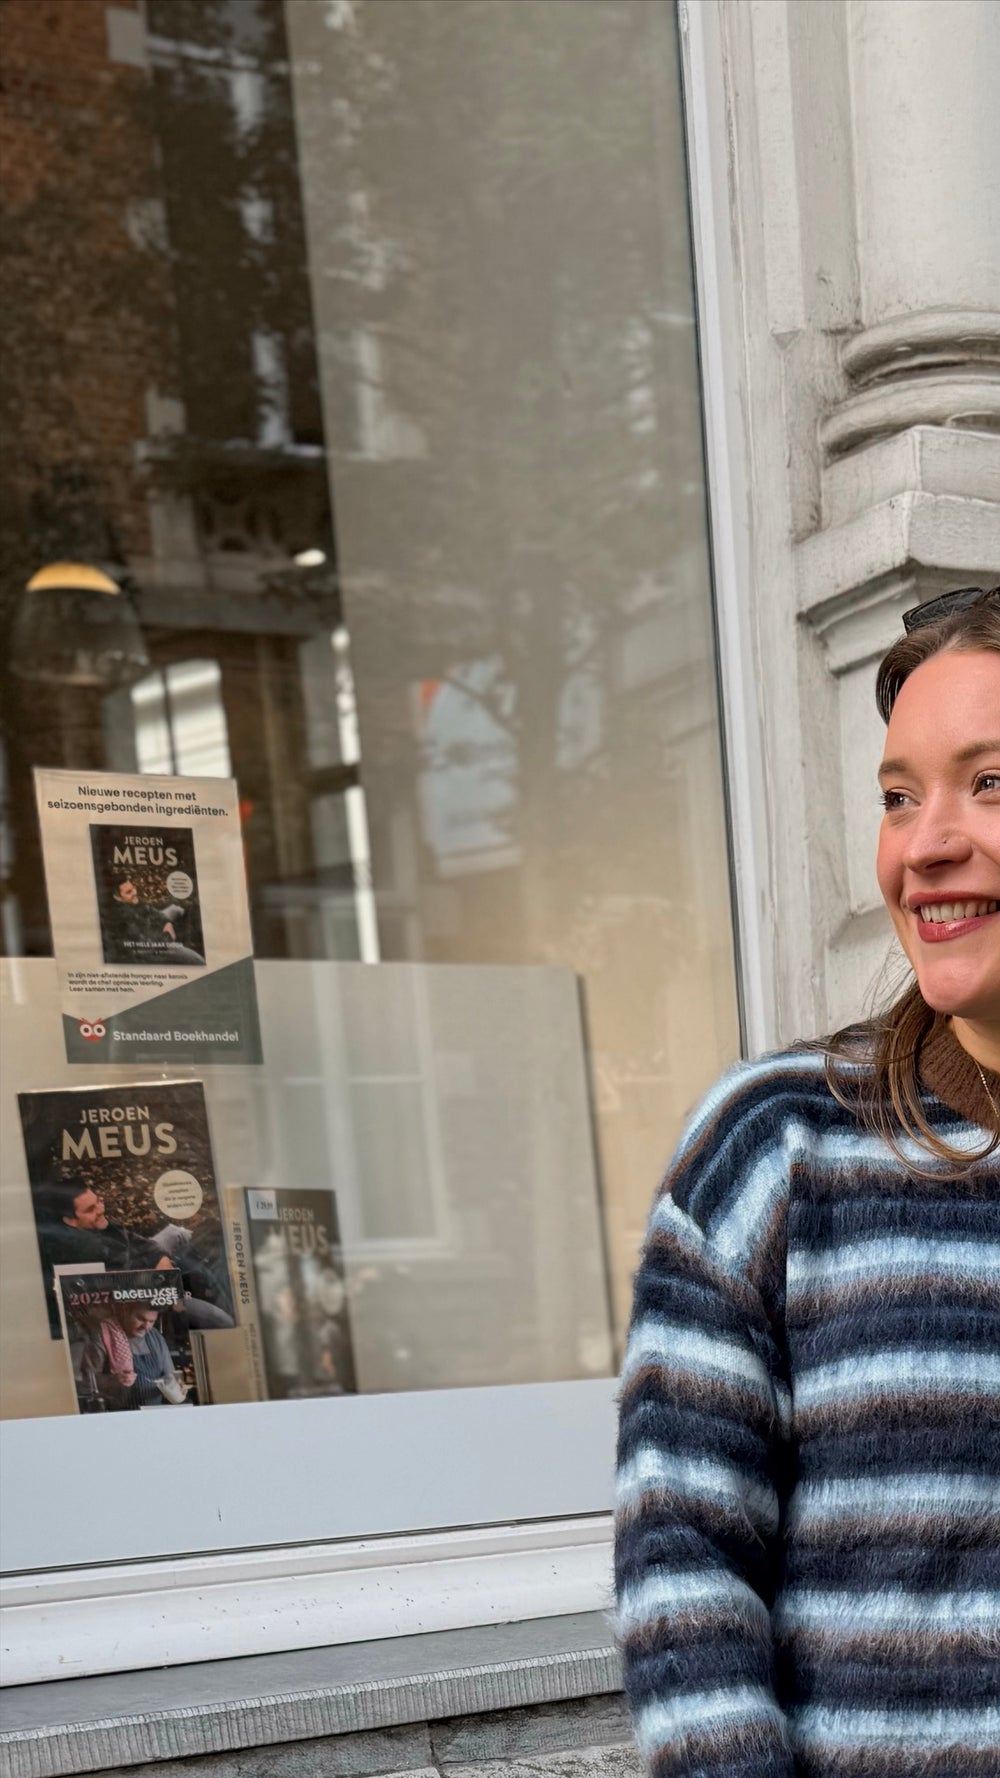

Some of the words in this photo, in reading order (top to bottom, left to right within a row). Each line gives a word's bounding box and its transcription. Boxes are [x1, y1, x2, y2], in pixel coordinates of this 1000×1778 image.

[78, 786, 120, 798] Nieuwe
[122, 789, 173, 801] recepten
[174, 792, 197, 801] met
[47, 798, 154, 814] seizoensgebonden
[155, 803, 229, 817] ingrediënten.
[124, 836, 164, 846] JEROEN
[113, 845, 178, 867] MEUS
[113, 1030, 172, 1042] Standaard
[173, 1031, 240, 1042] Boekhandel
[80, 1105, 150, 1124] JEROEN
[62, 1122, 178, 1161] MEUS
[279, 1207, 315, 1222] JEROEN
[232, 1221, 246, 1268] JEROEN
[70, 1291, 110, 1306] 2027
[112, 1287, 178, 1300] DAGELIJKSE
[238, 1272, 250, 1305] MEUS
[150, 1296, 179, 1307] KOST
